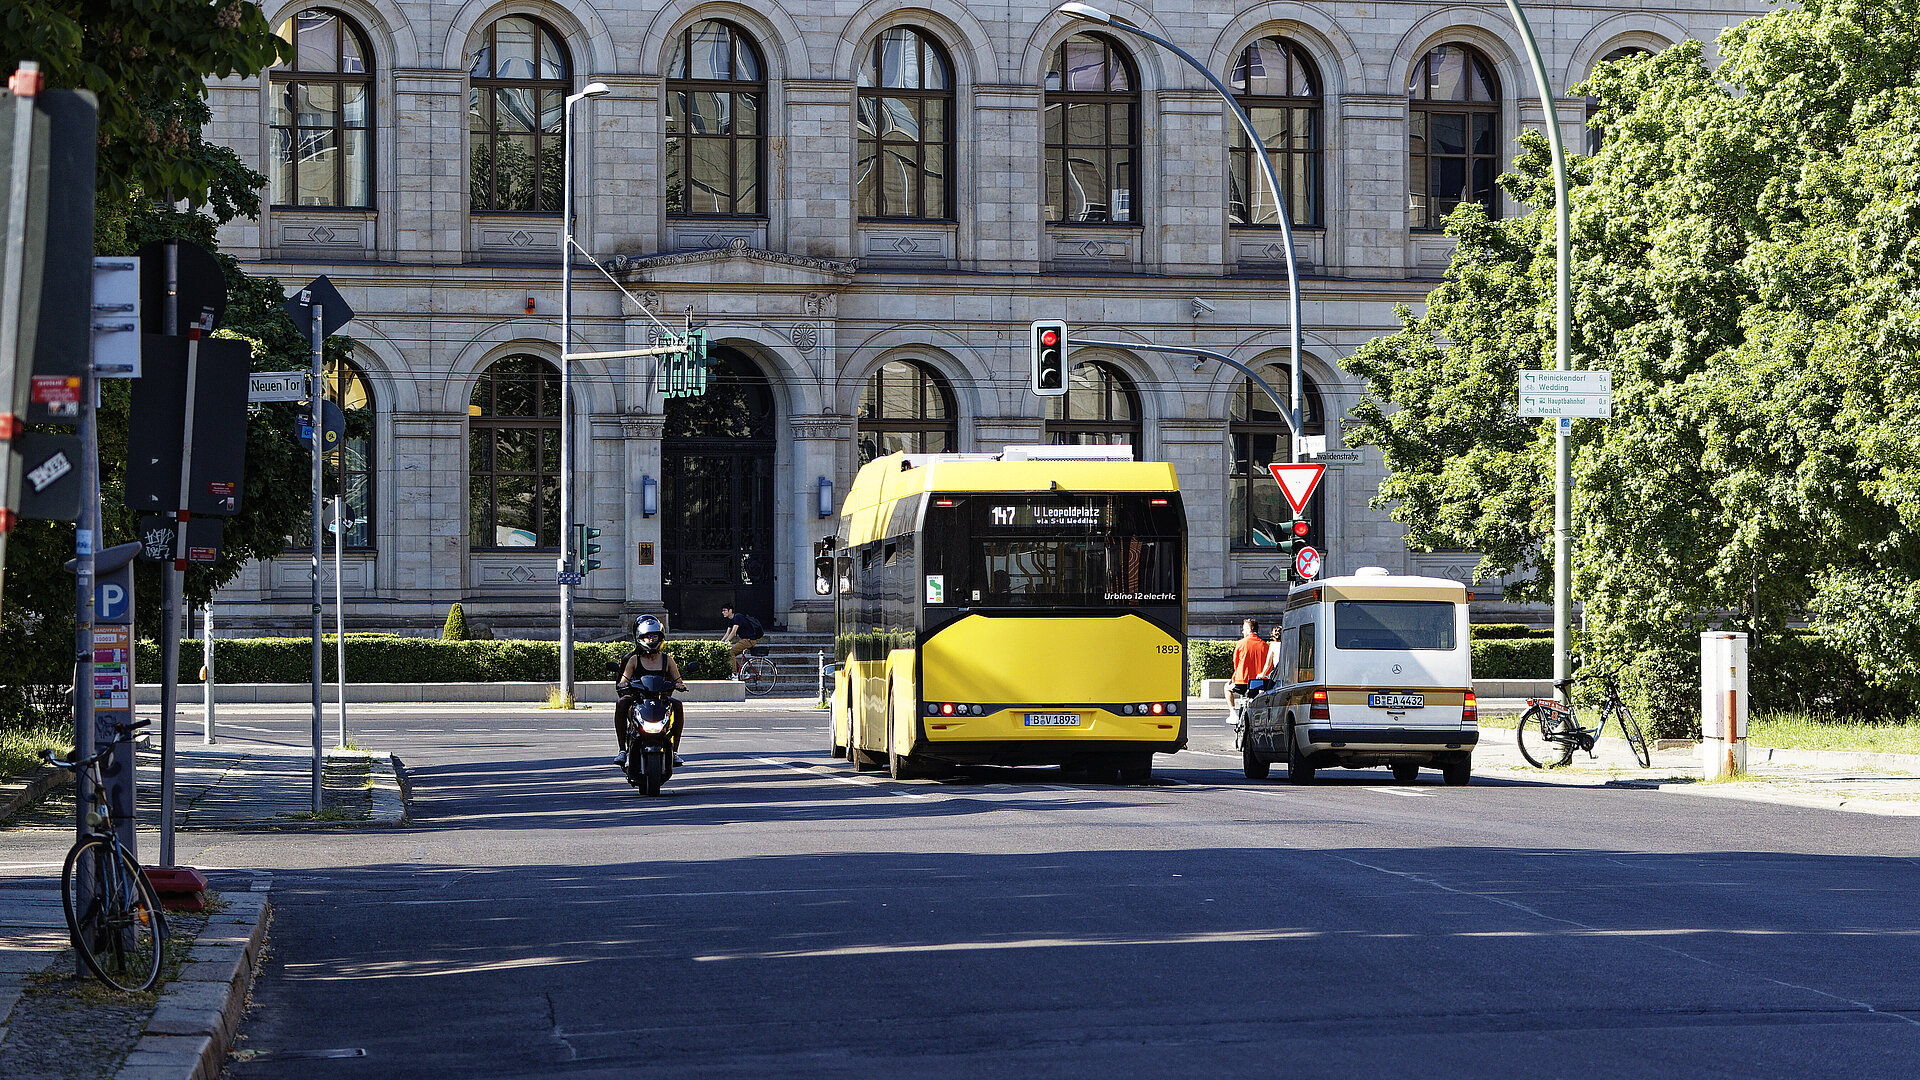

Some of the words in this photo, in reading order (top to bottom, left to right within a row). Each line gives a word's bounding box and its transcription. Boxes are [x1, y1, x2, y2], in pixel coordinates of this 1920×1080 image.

[1538, 374, 1586, 382] Reinickendorf
[251, 379, 282, 392] Neuen
[283, 378, 300, 391] Tor
[1538, 384, 1569, 392] Wedding
[1547, 397, 1586, 405] Hauptbahnhof
[991, 506, 1016, 525] 147
[1033, 506, 1040, 517] U
[1043, 506, 1100, 518] Leopoldplatz
[102, 584, 124, 617] P
[1104, 592, 1133, 600] Urbino
[1143, 592, 1176, 600] electric
[1156, 645, 1180, 654] 1893
[1374, 696, 1381, 705] B
[1386, 696, 1399, 705] EA
[1400, 696, 1423, 706] 4432
[1033, 716, 1040, 725] B
[1045, 716, 1052, 725] V
[1053, 716, 1076, 725] 1893
